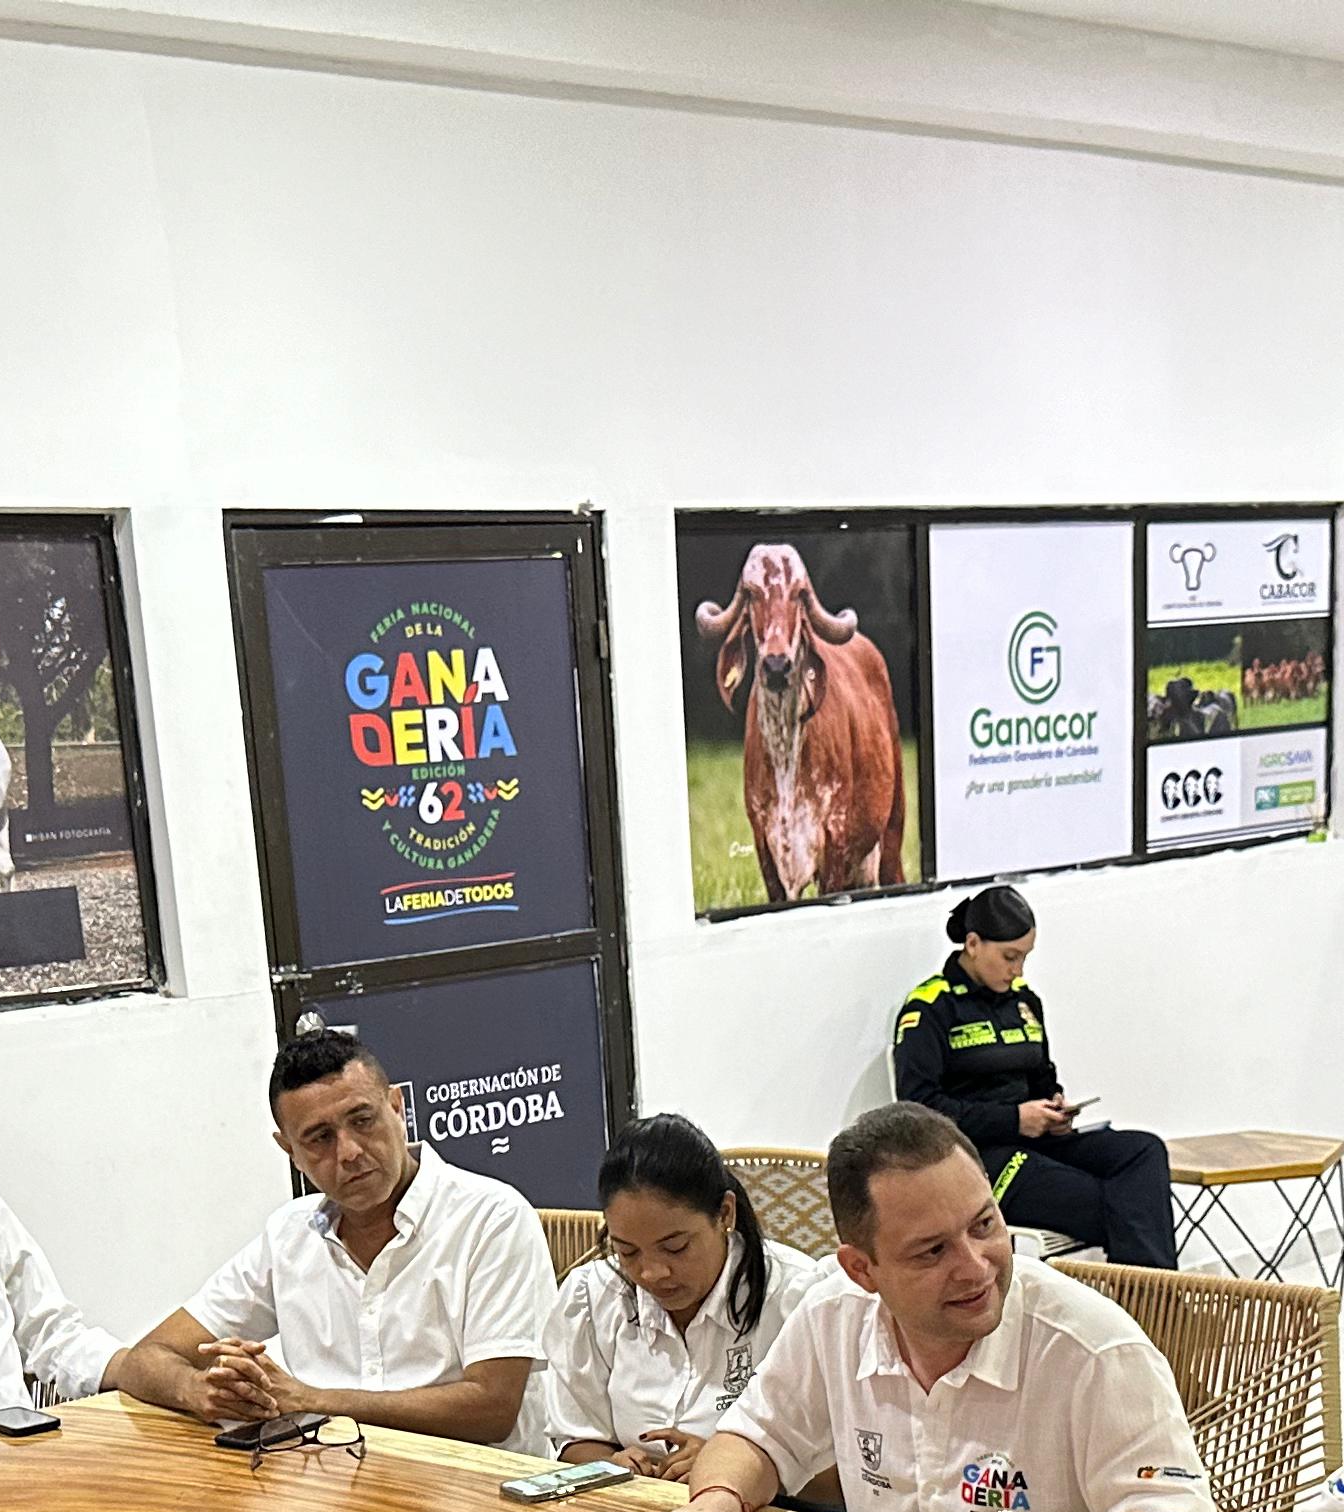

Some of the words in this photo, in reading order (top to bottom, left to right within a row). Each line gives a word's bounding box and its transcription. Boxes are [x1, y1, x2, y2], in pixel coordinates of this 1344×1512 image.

[370, 607, 406, 643] FERIA
[411, 602, 475, 640] NACIONAL
[404, 622, 423, 638] DE
[426, 622, 443, 637] LA
[345, 646, 509, 710] GANA
[970, 708, 1098, 748] Ganacor
[411, 765, 465, 780] EDICIÓN
[418, 781, 465, 824] 62
[382, 820, 392, 831] Y
[389, 833, 444, 870] CULTURA
[447, 808, 501, 868] GANADERA
[408, 822, 476, 850] TRADICIÓN
[426, 1066, 539, 1104] GOBERNACIÓN
[541, 1064, 562, 1083] DE
[429, 1090, 565, 1142] CÓRDOBA
[963, 1463, 1028, 1490] GANA
